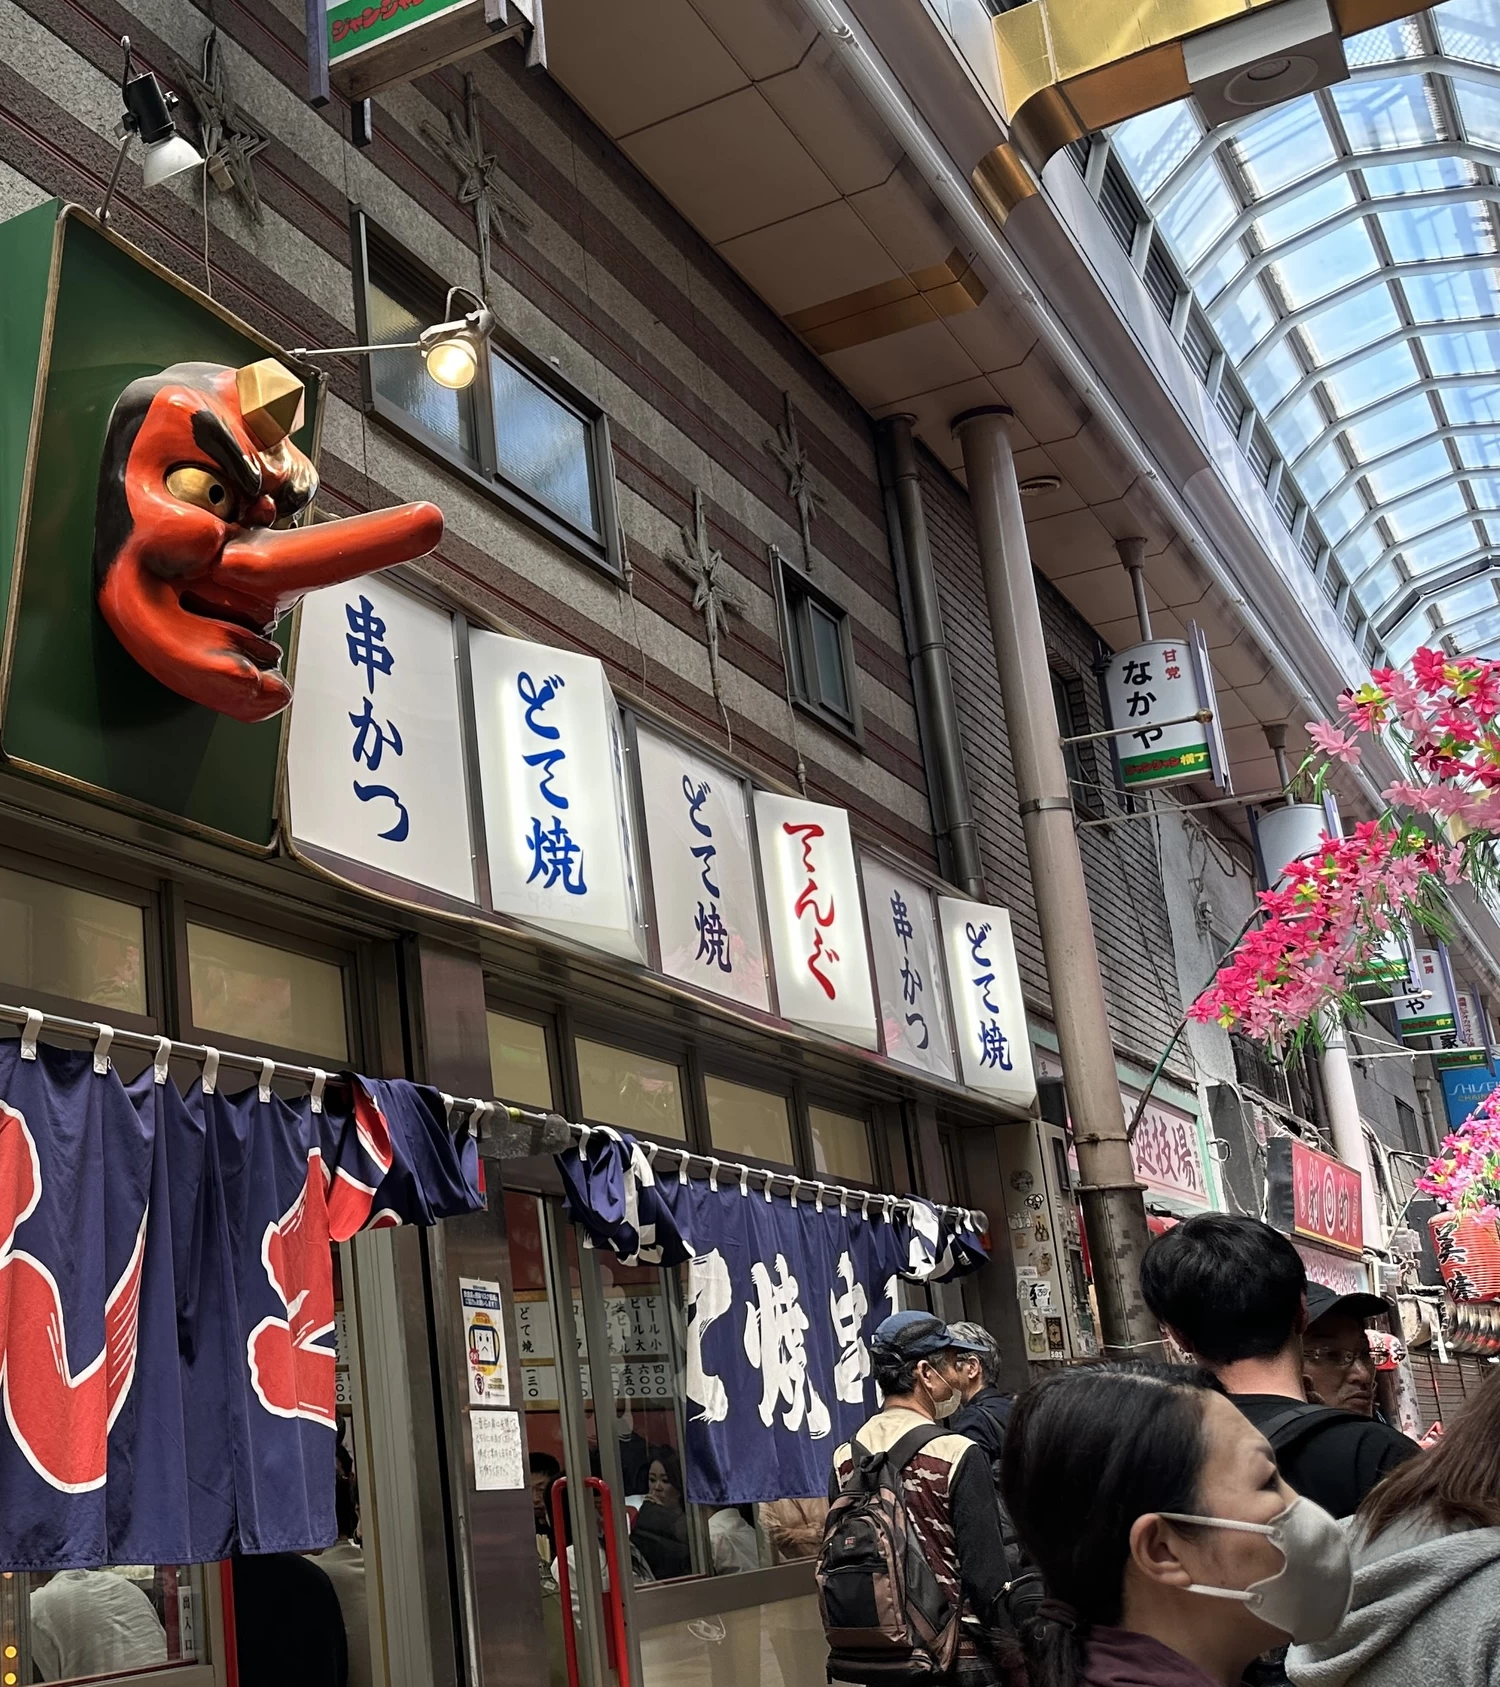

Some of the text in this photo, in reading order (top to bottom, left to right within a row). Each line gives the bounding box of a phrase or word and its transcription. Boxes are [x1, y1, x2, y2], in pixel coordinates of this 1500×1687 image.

[345, 594, 410, 842] 串かつ
[1122, 660, 1163, 749] なかや
[1162, 648, 1181, 681] 甘党
[517, 671, 587, 895] どて焼
[682, 774, 733, 973] どて焼
[782, 821, 840, 1000] てんぐ
[889, 889, 929, 1050] 串かつ
[965, 922, 1013, 1071] どて焼
[520, 1306, 534, 1353] どて焼
